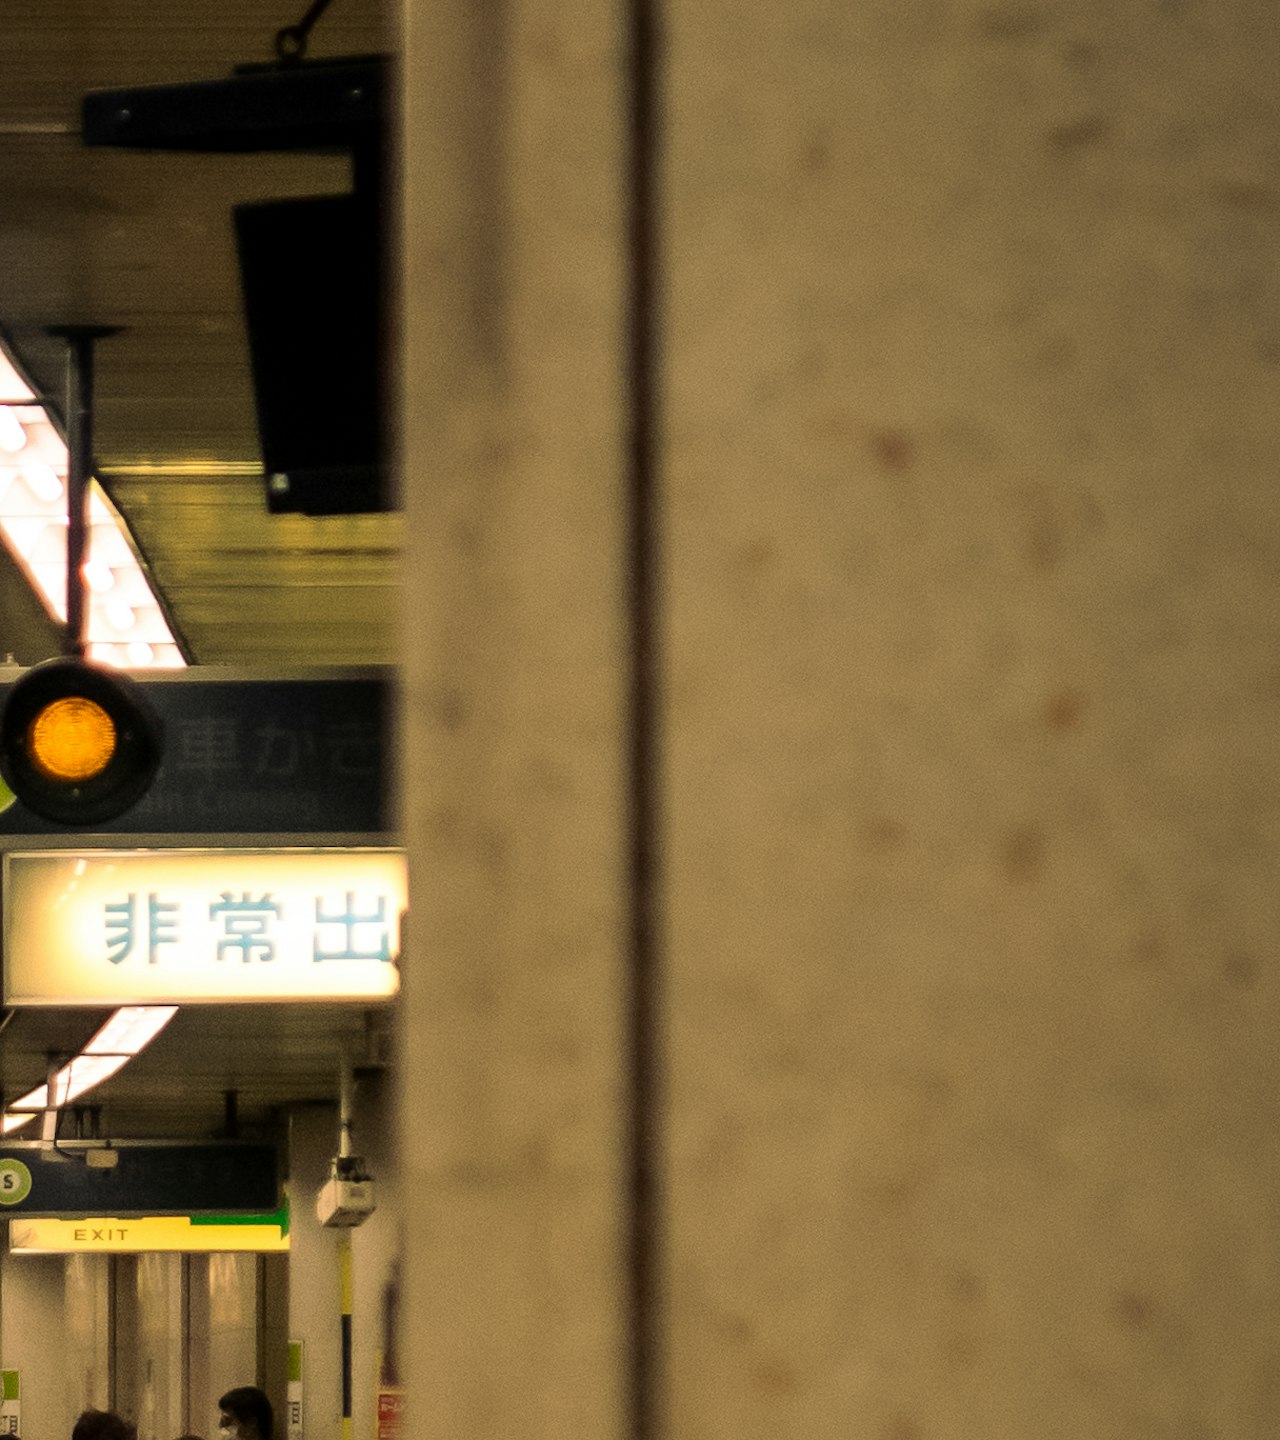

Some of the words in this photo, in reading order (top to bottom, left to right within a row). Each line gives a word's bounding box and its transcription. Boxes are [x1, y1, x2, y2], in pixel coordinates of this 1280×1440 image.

[104, 890, 390, 964] 非常出
[1, 1173, 14, 1190] S
[74, 1229, 129, 1241] EXIT
